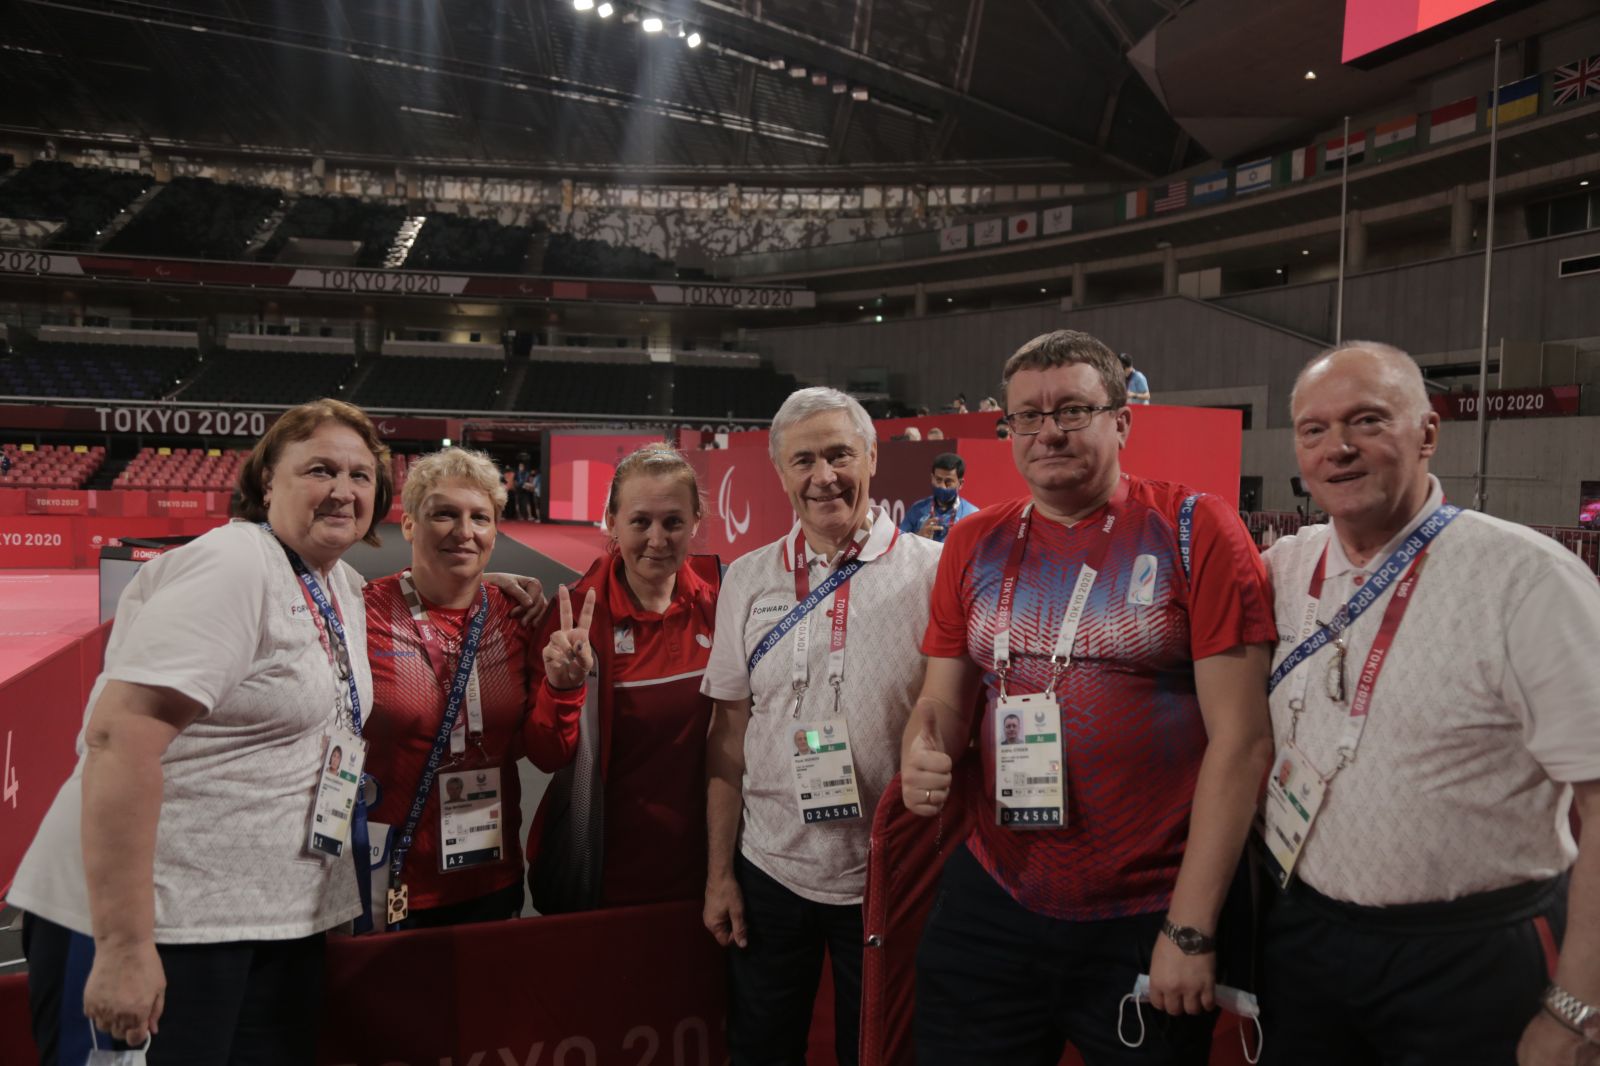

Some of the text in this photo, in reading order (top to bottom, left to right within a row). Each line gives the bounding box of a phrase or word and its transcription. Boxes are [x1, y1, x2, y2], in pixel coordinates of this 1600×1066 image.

[319, 270, 440, 293] TOKYO 2020
[679, 285, 793, 306] TOKYO 2020
[1507, 394, 1544, 411] 2020
[95, 407, 265, 437] TOKYO 2020
[36, 498, 79, 507] TOKYO 2020
[157, 500, 181, 508] TOKYO
[1179, 518, 1190, 541] RPC
[1420, 516, 1444, 538] RPC
[26, 533, 62, 547] 2020
[1396, 536, 1423, 562] RPC
[839, 561, 857, 580] RPC
[1374, 562, 1399, 588] RPC
[819, 577, 837, 597] RPC
[1068, 572, 1093, 623] TOKYO 2020
[312, 588, 329, 609] RPC
[799, 595, 817, 613] RPC
[997, 576, 1013, 628] TOKYO 2020
[1349, 587, 1374, 613] RPC
[752, 604, 789, 616] FORWARD
[780, 612, 799, 632] RPC
[832, 599, 845, 647] TOKYO 2020
[468, 627, 480, 647] RPC
[763, 632, 780, 650] RPC
[797, 626, 806, 652] TOKYO
[1304, 632, 1327, 653] RPC
[461, 648, 474, 670] RPC
[752, 650, 765, 667] RPC
[1282, 650, 1302, 672] RPC
[454, 673, 468, 694] RPC
[1354, 648, 1384, 711] TOKYO 2020
[445, 697, 460, 718] RPC
[437, 722, 452, 744] RPC
[429, 746, 443, 770] RPC
[422, 772, 434, 793] RPC
[410, 796, 424, 818] RPC
